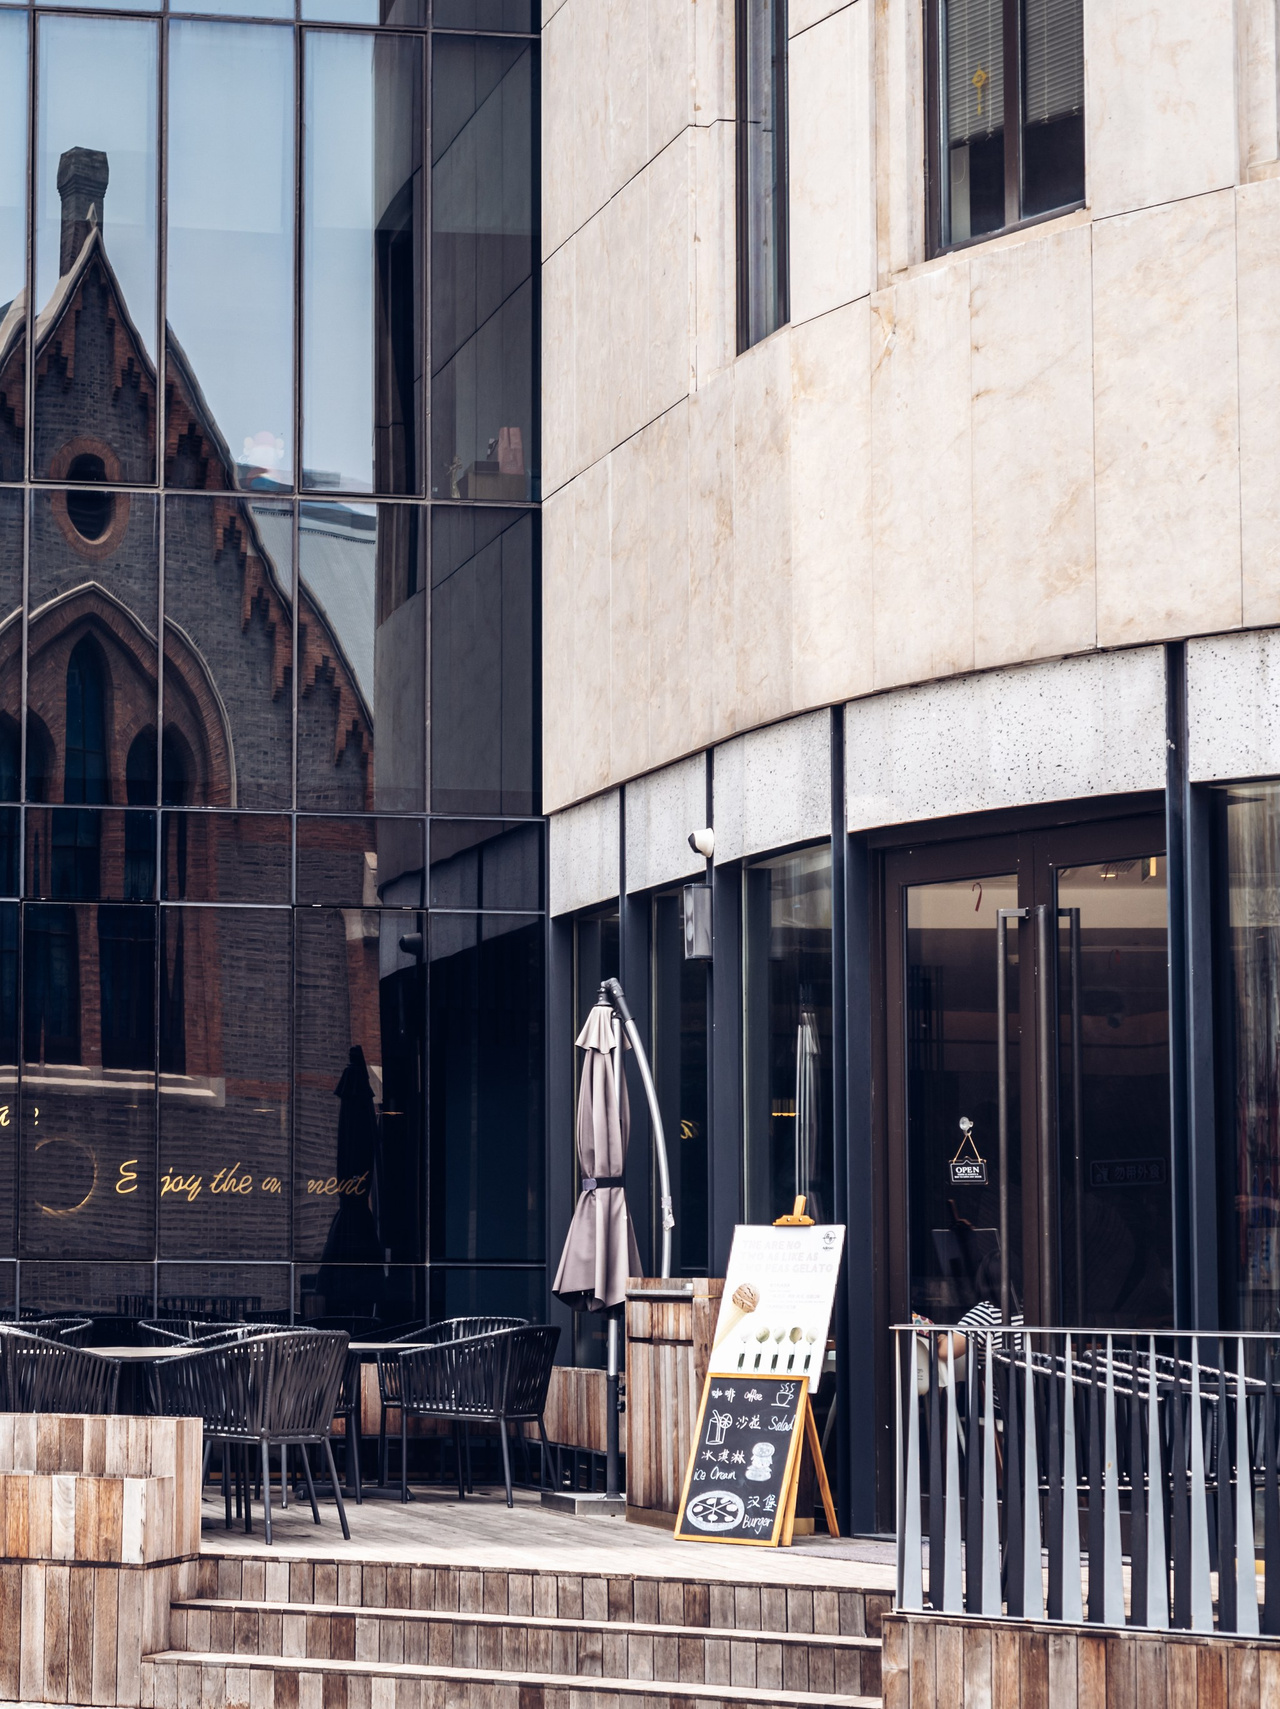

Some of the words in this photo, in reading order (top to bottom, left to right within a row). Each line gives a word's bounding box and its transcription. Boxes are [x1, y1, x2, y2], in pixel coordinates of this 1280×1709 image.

[955, 1166, 980, 1174] OPEN
[1115, 1164, 1160, 1180] 勿带外食
[115, 1159, 202, 1202] Ejoy
[210, 1161, 253, 1194] the
[261, 1171, 370, 1195] mment
[786, 1240, 802, 1250] NO
[782, 1252, 805, 1262] LIKE
[806, 1252, 819, 1262] AS
[765, 1263, 791, 1273] PEAS
[792, 1263, 834, 1273] GELATO
[735, 1414, 761, 1430] 沙拉
[768, 1414, 797, 1432] Salad
[701, 1450, 747, 1465] 冰淇淋
[710, 1466, 737, 1481] Cream
[746, 1494, 778, 1512] 汉堡
[742, 1514, 774, 1535] Burger
